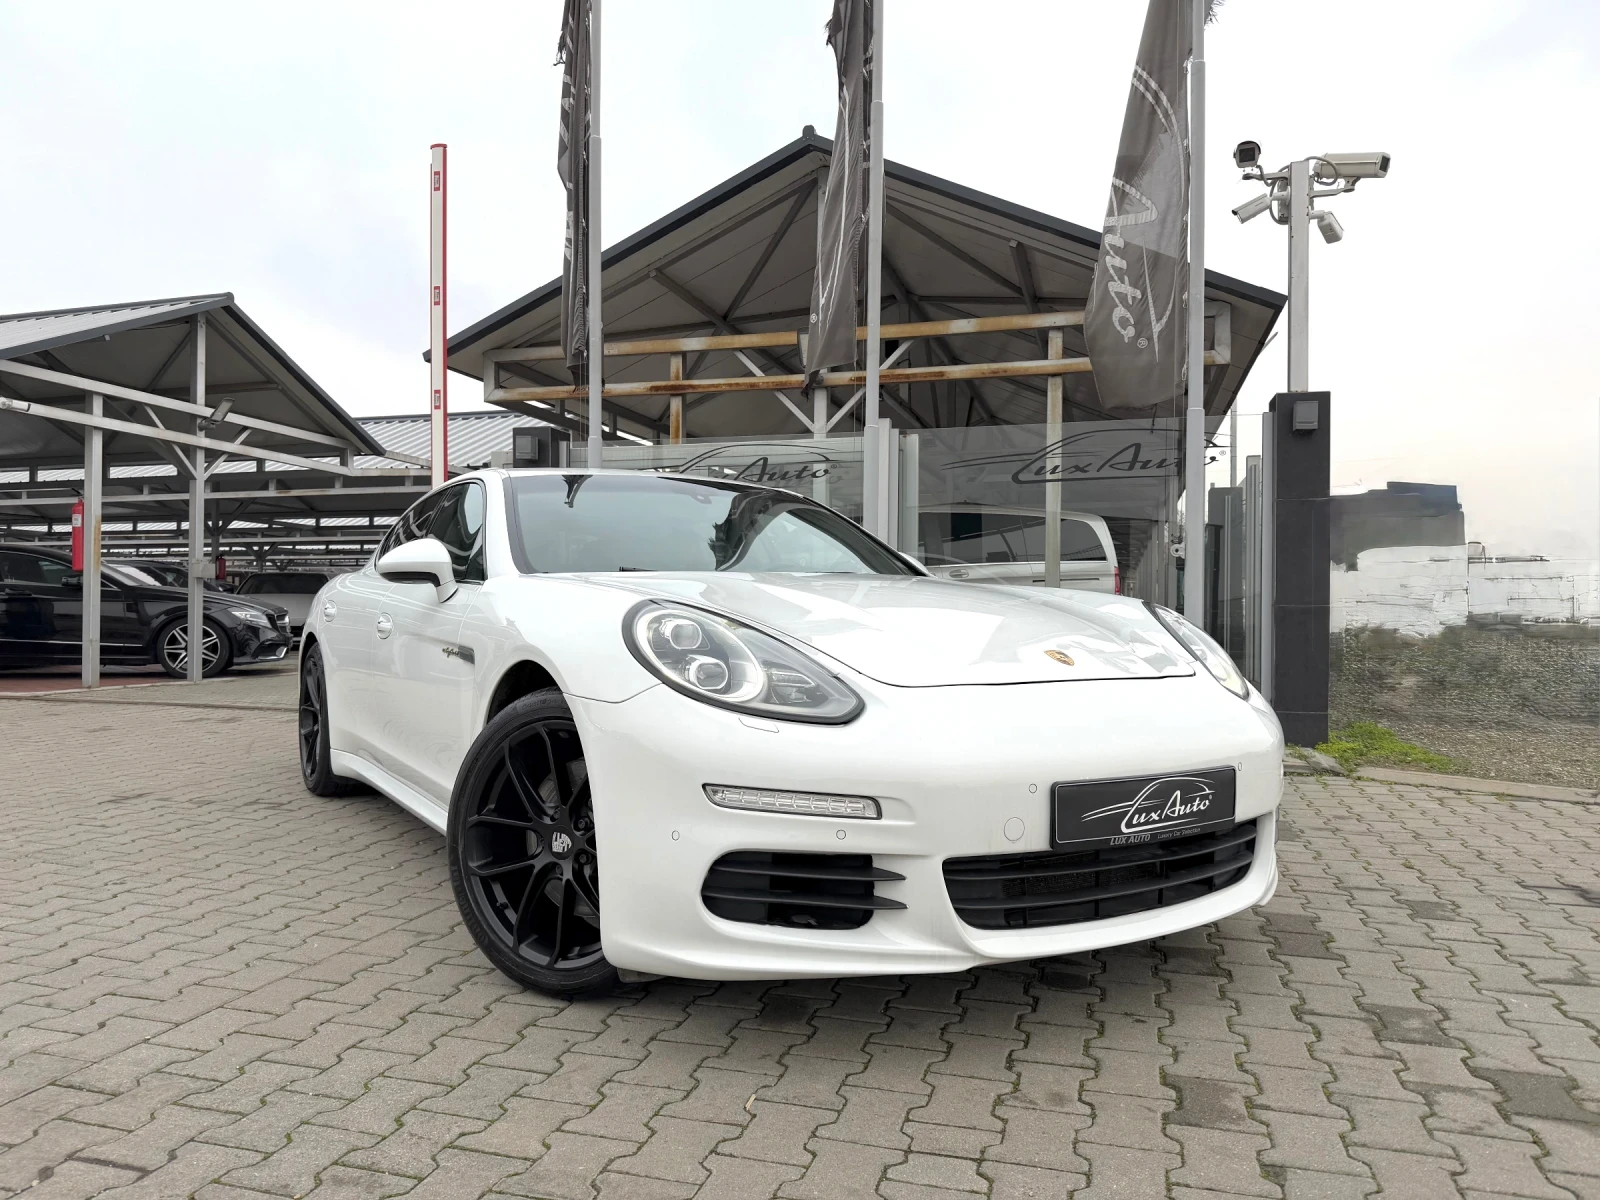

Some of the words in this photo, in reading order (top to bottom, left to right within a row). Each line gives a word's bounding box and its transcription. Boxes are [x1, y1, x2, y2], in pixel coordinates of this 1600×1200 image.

[1104, 176, 1159, 343] Auto
[733, 456, 831, 483] Auto
[1012, 446, 1092, 485] Lux
[1120, 797, 1161, 833] Lux
[1161, 789, 1211, 819] Auto
[1109, 836, 1127, 845] LUX
[1128, 833, 1151, 844] AUTO
